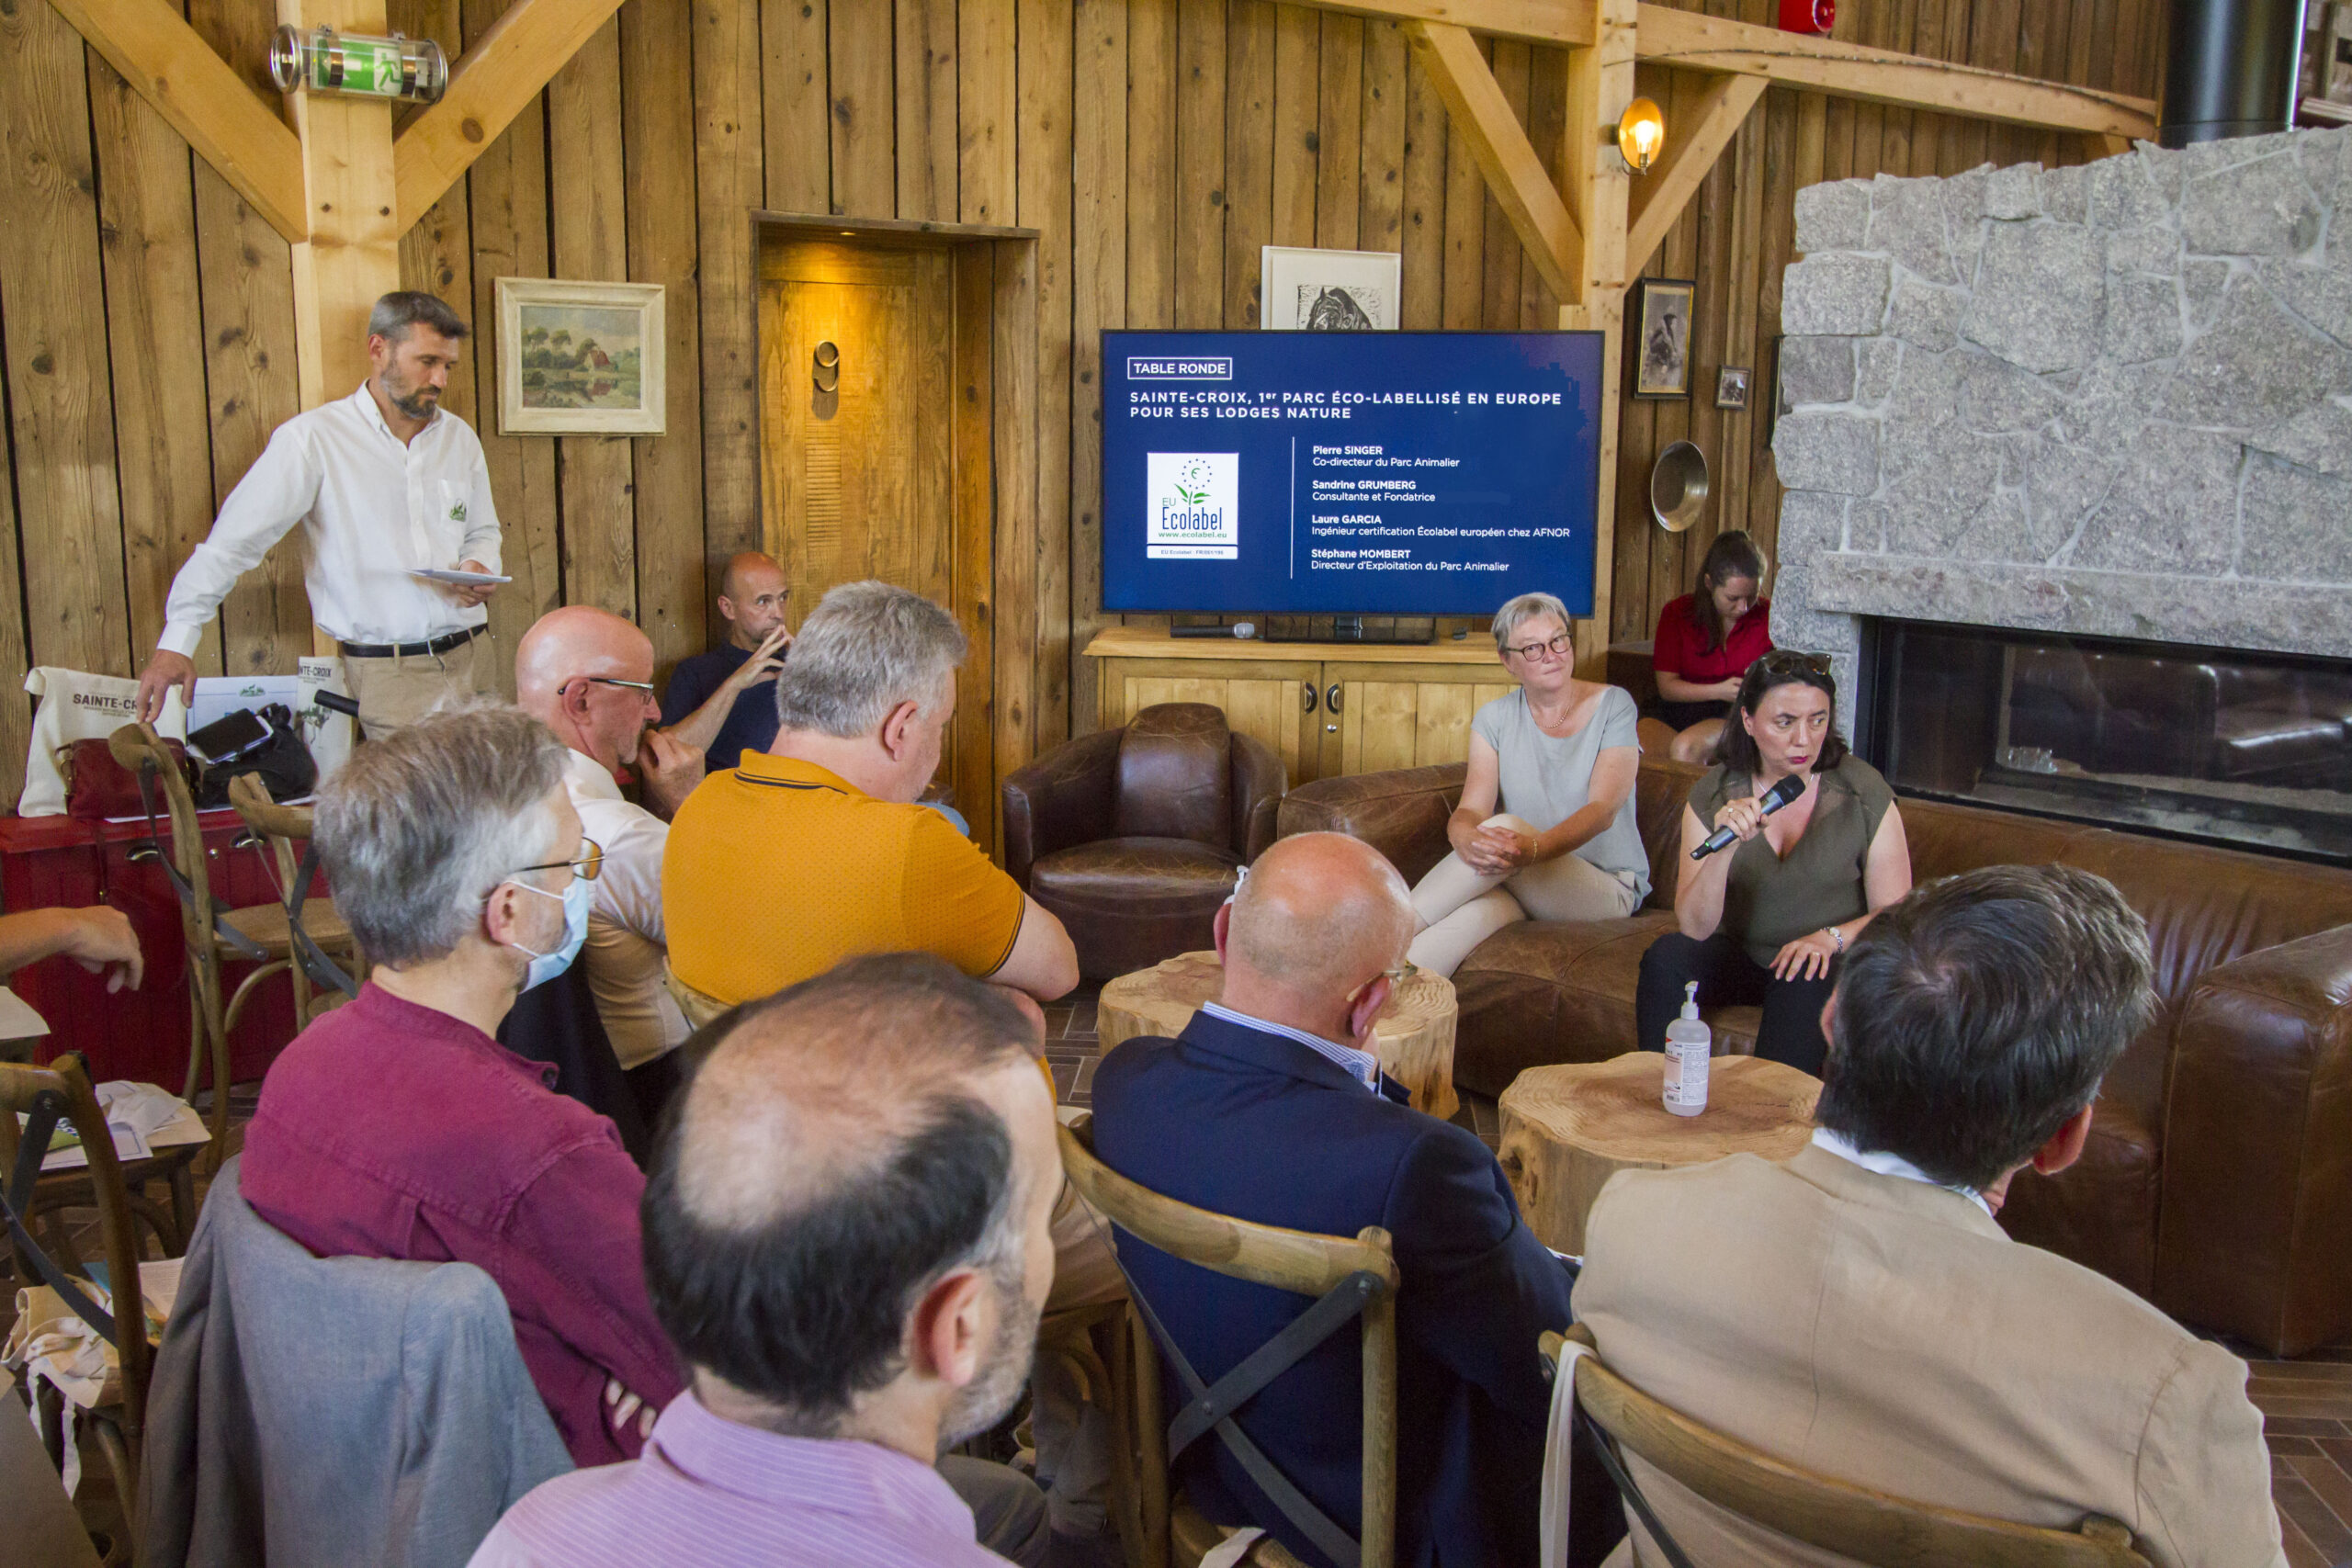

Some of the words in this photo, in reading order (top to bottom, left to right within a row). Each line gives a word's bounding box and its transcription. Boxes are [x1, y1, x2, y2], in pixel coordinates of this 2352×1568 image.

[1134, 362, 1176, 374] TABLE
[1179, 362, 1227, 375] RONDE
[1130, 392, 1251, 406] SAINTE-CROIX,
[1283, 392, 1325, 403] PARC
[1332, 390, 1460, 404] ÉCO-LABELLISÉ
[1467, 392, 1488, 404] EN
[1496, 393, 1561, 404] EUROPE
[1131, 406, 1173, 417] POUR
[1181, 406, 1209, 418] SES
[1216, 406, 1281, 418] LODGES
[1287, 407, 1351, 418] NATURE
[1313, 446, 1342, 455] Pierre
[1344, 446, 1384, 455] SINGER
[1313, 457, 1373, 466] Co-directeur
[1375, 457, 1388, 466] du
[1391, 457, 1411, 467] Parc
[1415, 457, 1460, 467] Animalier
[1313, 479, 1355, 489] Sandrine
[1358, 480, 1416, 490] GRUMBERG
[1162, 498, 1176, 506] EU
[1312, 491, 1369, 501] Consultante
[1385, 492, 1435, 502] Fondatrice
[1162, 507, 1222, 530] Ecolabel
[1312, 514, 1340, 524] Laure
[1342, 514, 1382, 524] GARCIA
[1312, 526, 1356, 536] Ingénieur
[1359, 526, 1415, 536] certification
[1418, 525, 1457, 536] Écolabel
[1460, 527, 1505, 537] européen
[1508, 528, 1531, 536] chez
[1532, 528, 1570, 536] AFNOR
[1312, 548, 1357, 559] Stéphane
[1360, 549, 1411, 558] MOMBERT
[1312, 560, 1355, 570] Directeur
[1429, 562, 1438, 570] du
[1441, 561, 1461, 570] Parc
[1464, 562, 1510, 570] Animalier
[299, 666, 332, 678] NTE-CROIX
[73, 694, 137, 710] SAINTE-CR
